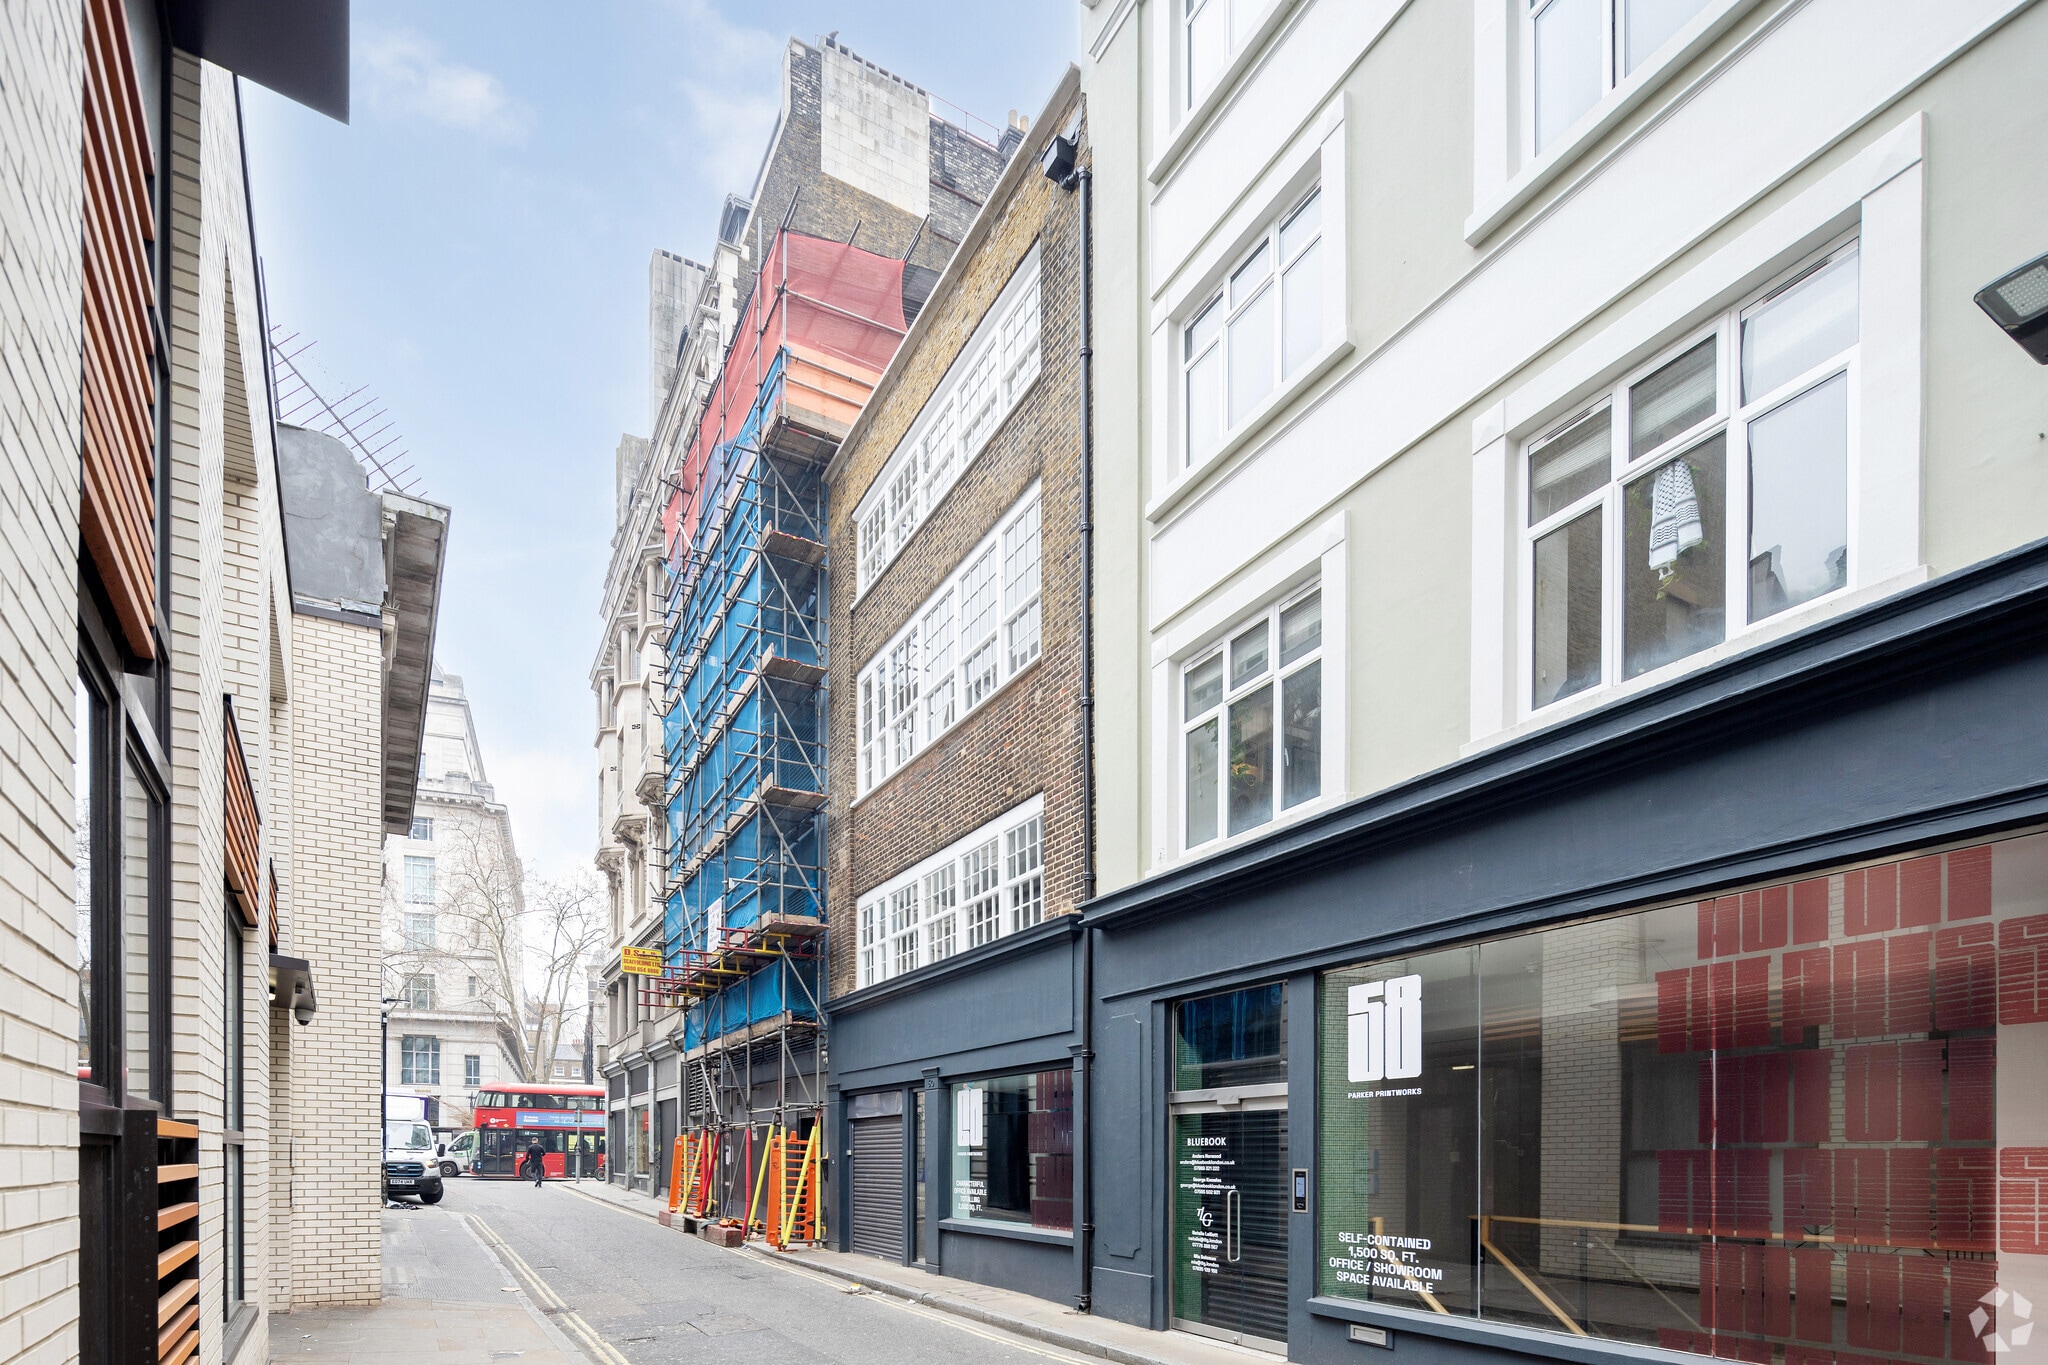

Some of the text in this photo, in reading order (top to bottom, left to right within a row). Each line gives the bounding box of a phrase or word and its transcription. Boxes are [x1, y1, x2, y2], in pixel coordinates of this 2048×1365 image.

[1348, 974, 1422, 1083] 58
[1348, 1087, 1422, 1099] PARKER PRINTWORKS
[1187, 1137, 1227, 1146] BLUEBOOK
[1338, 1231, 1431, 1250] SELF-CONTAINED
[1348, 1246, 1420, 1264] 1,500 SQ. FT.
[1329, 1257, 1443, 1280] OFFICE / SHOWROOM
[1336, 1271, 1434, 1294] SPACE AVAILABLE
